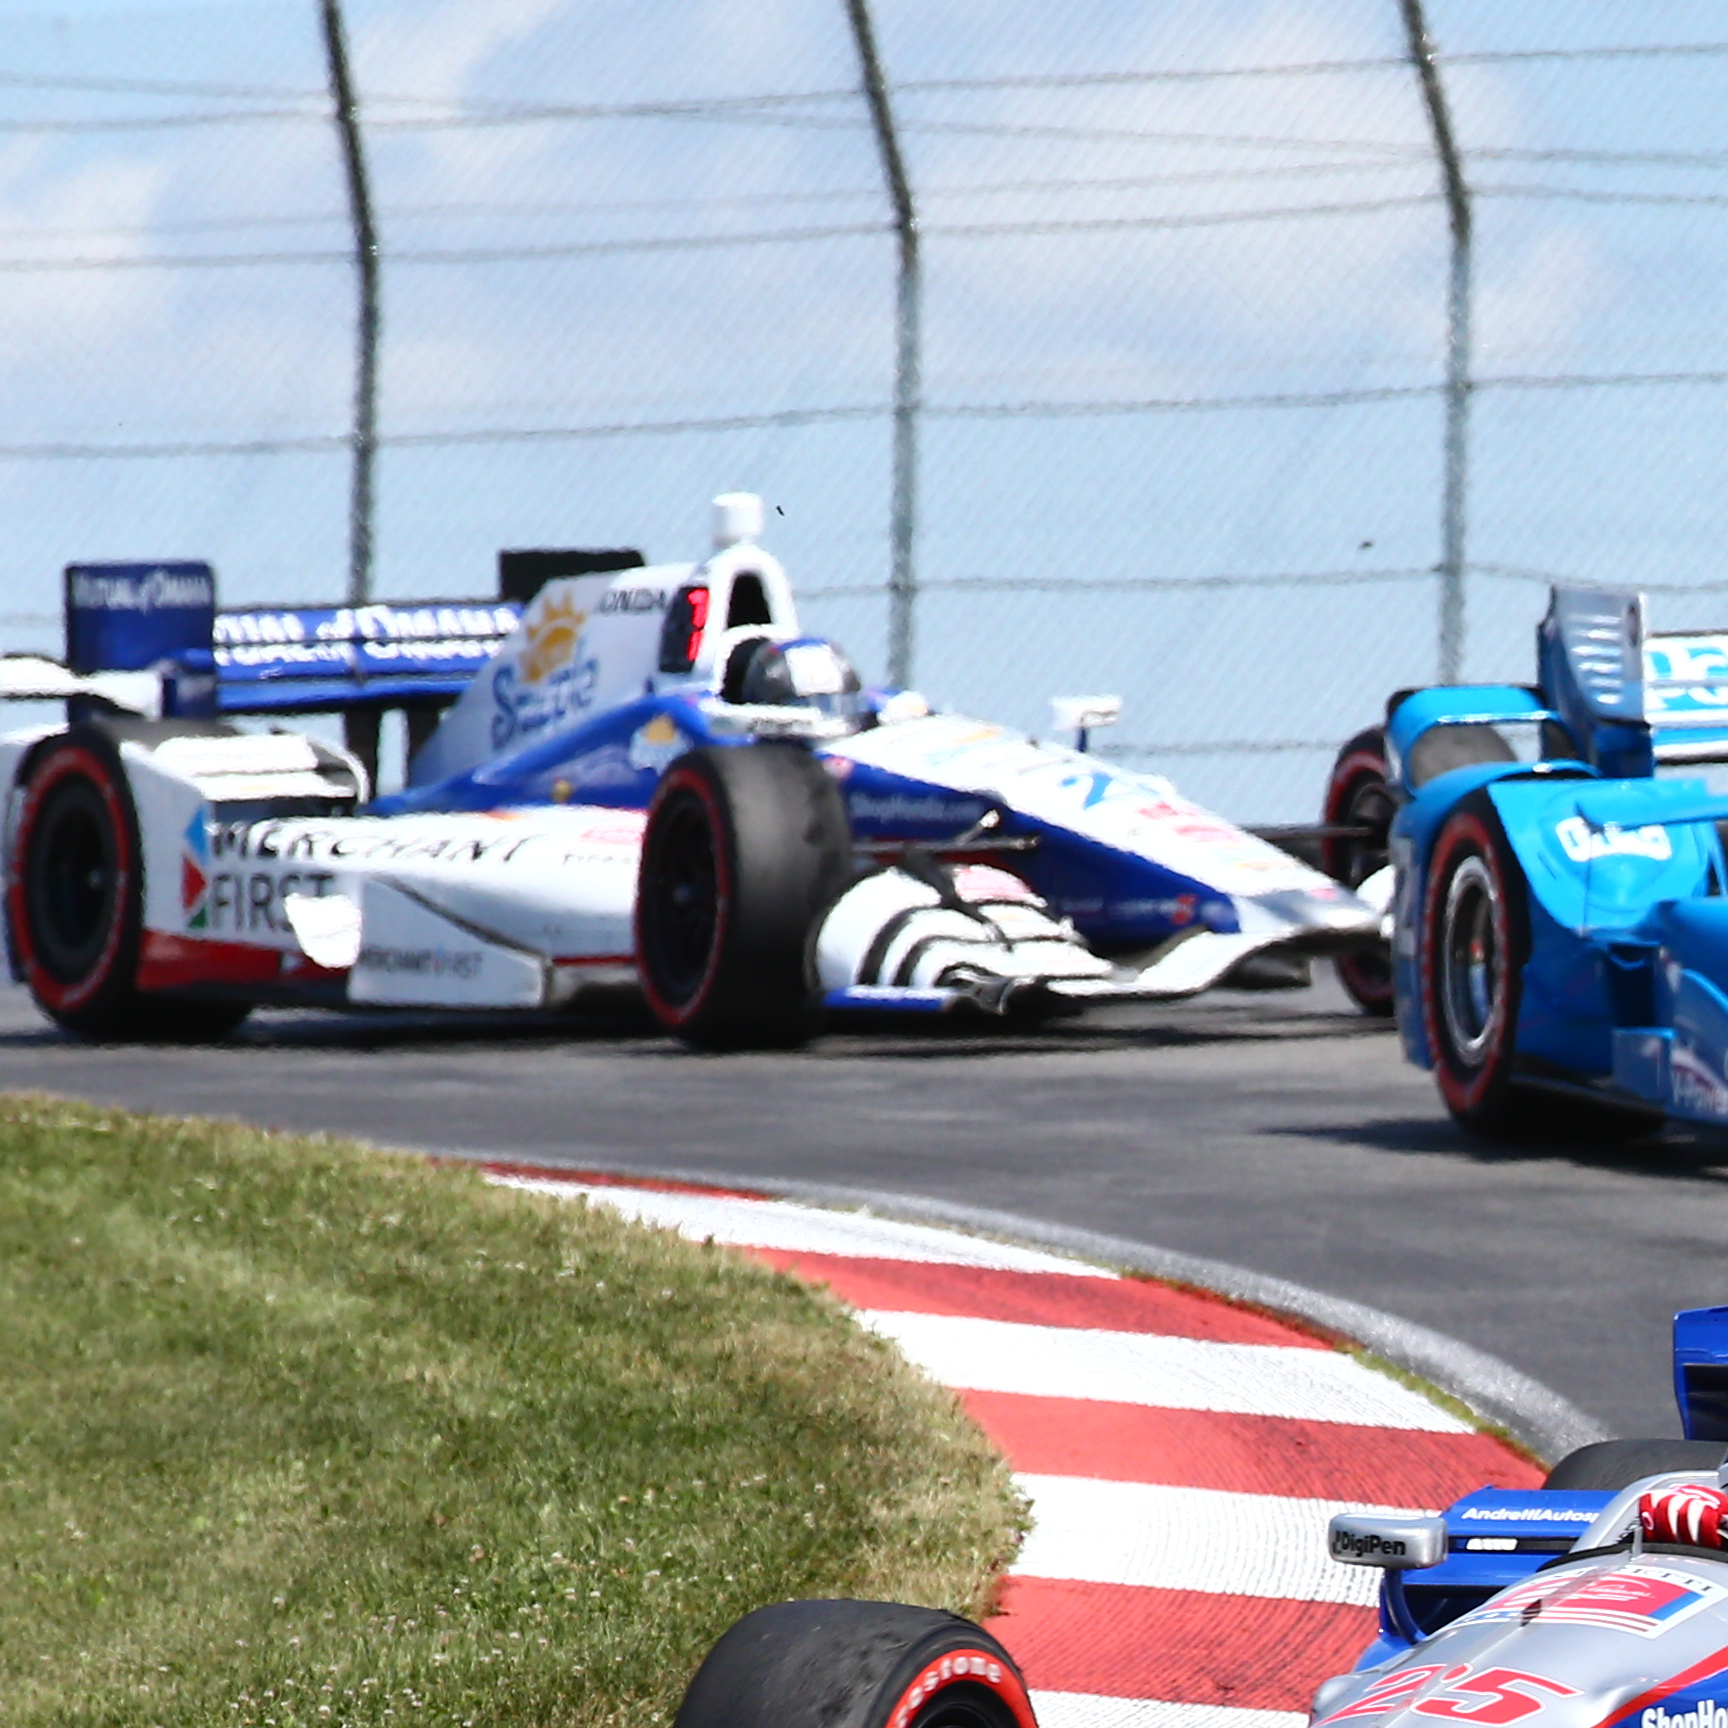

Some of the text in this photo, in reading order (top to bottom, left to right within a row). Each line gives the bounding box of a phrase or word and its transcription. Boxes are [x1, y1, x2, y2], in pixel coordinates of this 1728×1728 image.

[1462, 1508, 1599, 1524] AndrettiAutos
[1340, 1531, 1405, 1557] DigiPen
[1311, 1663, 1586, 1728] 25
